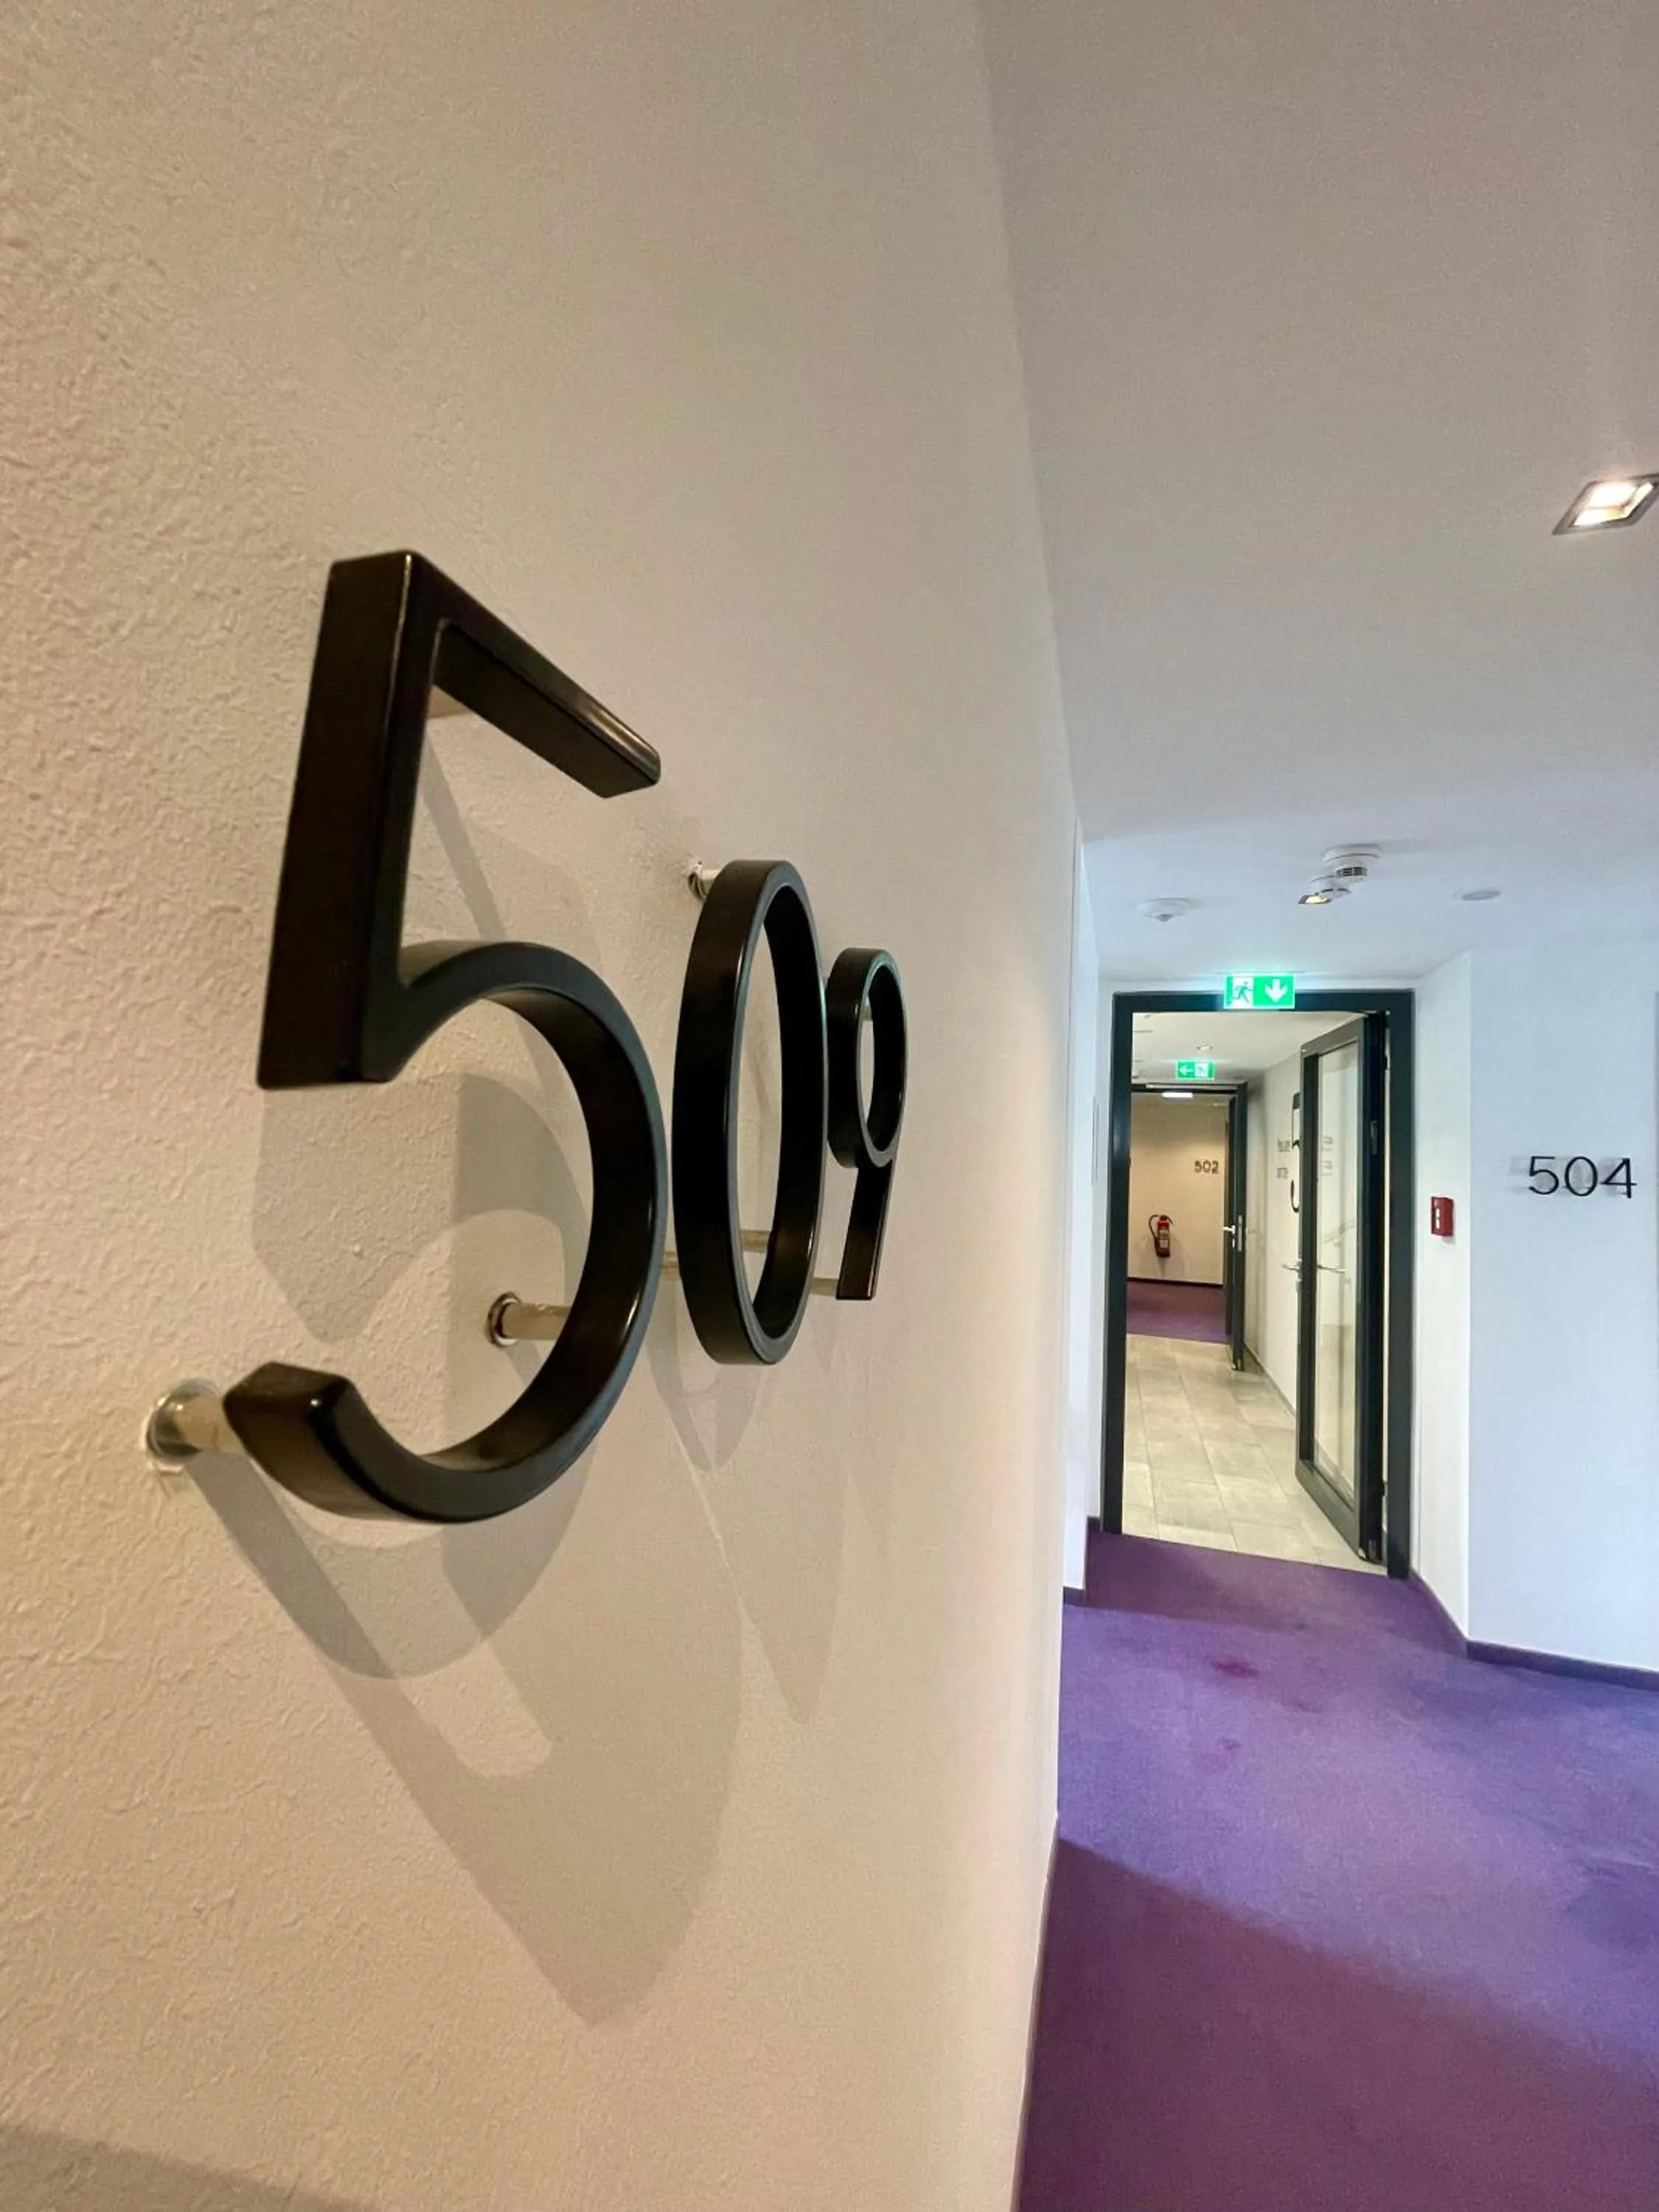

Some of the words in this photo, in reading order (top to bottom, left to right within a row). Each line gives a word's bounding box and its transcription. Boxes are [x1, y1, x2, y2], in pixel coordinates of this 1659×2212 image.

[223, 550, 907, 1523] 509
[1194, 1160, 1219, 1174] 502
[1528, 1155, 1637, 1198] 504
